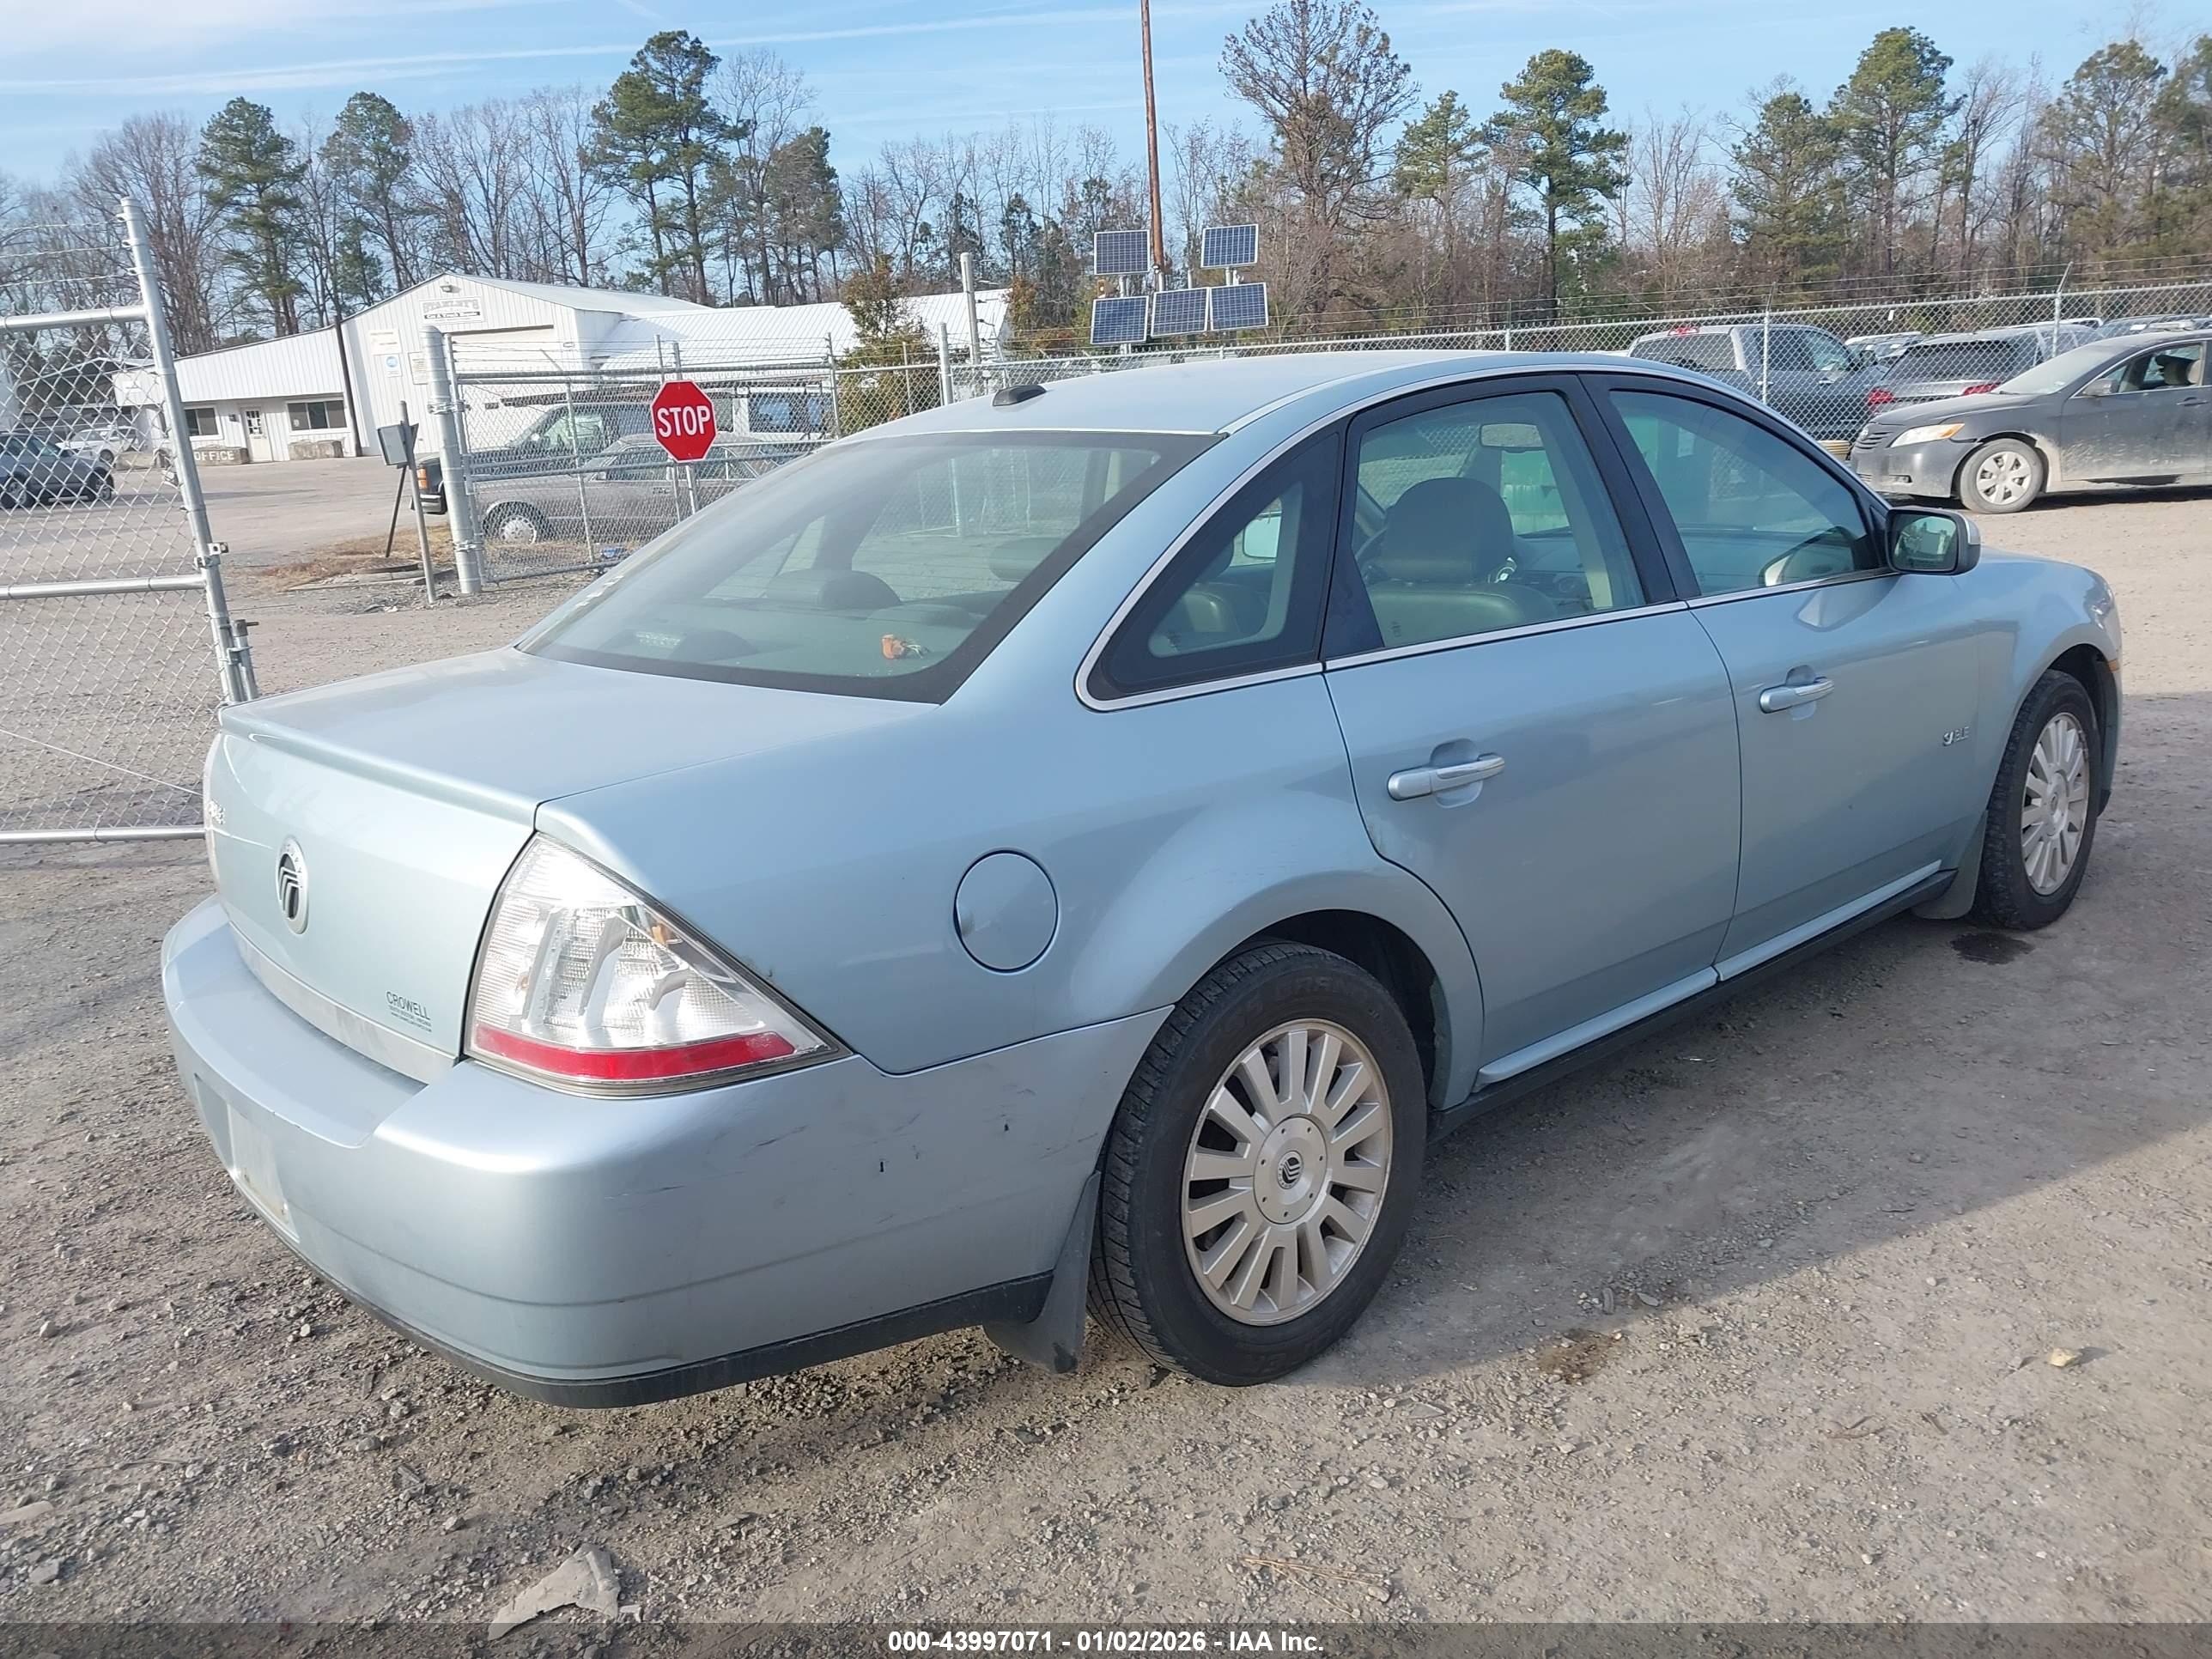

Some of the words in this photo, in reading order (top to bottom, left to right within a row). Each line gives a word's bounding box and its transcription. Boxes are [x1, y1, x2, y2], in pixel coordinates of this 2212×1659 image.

[657, 405, 711, 438] STOP
[194, 450, 234, 461] OFFICE
[386, 991, 431, 1020] CROWELL
